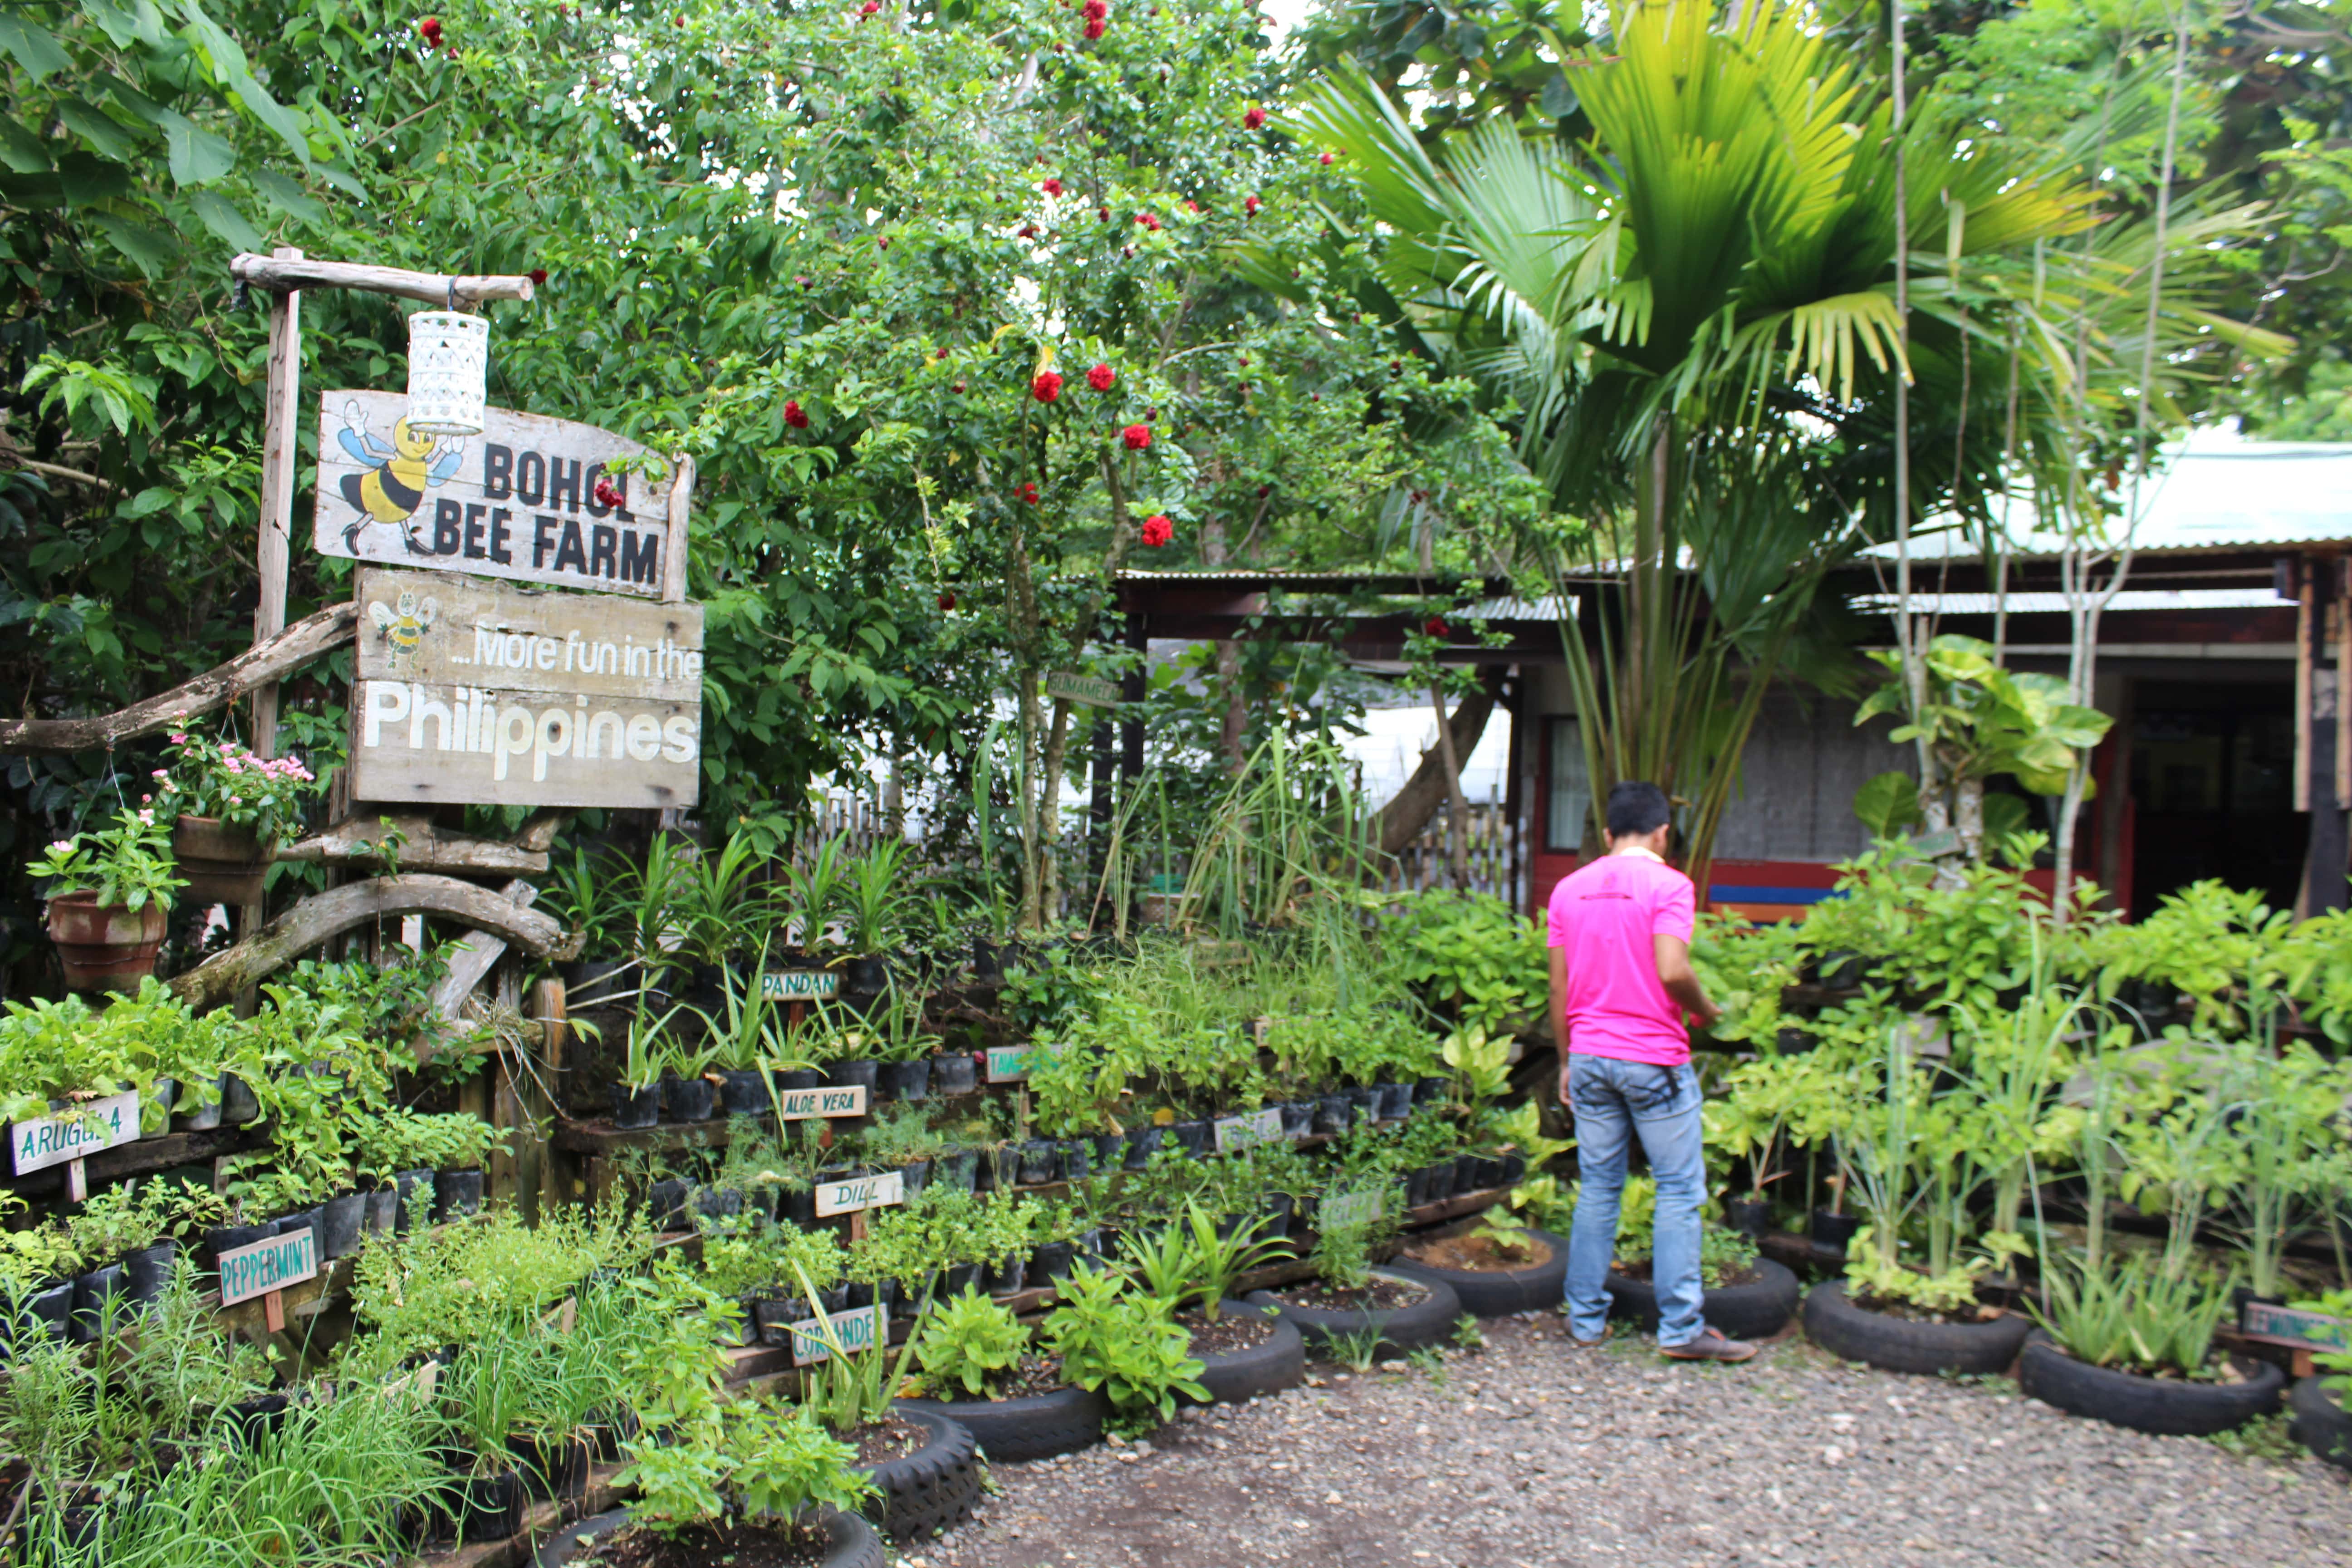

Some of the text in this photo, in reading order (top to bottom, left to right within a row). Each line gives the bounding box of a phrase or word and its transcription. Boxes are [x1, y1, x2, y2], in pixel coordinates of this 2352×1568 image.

[484, 442, 636, 523] BOHOL
[434, 498, 659, 584] BEE FARM
[565, 629, 618, 675] fun
[623, 635, 650, 677] in
[656, 638, 702, 681] the
[363, 681, 698, 782] Philippines
[761, 973, 835, 996] PANDAN
[785, 1092, 855, 1114] ALOE VERA
[20, 1106, 122, 1160] ARUGUA
[833, 1181, 879, 1206] DILL
[220, 1235, 311, 1300] PEPPERMINT
